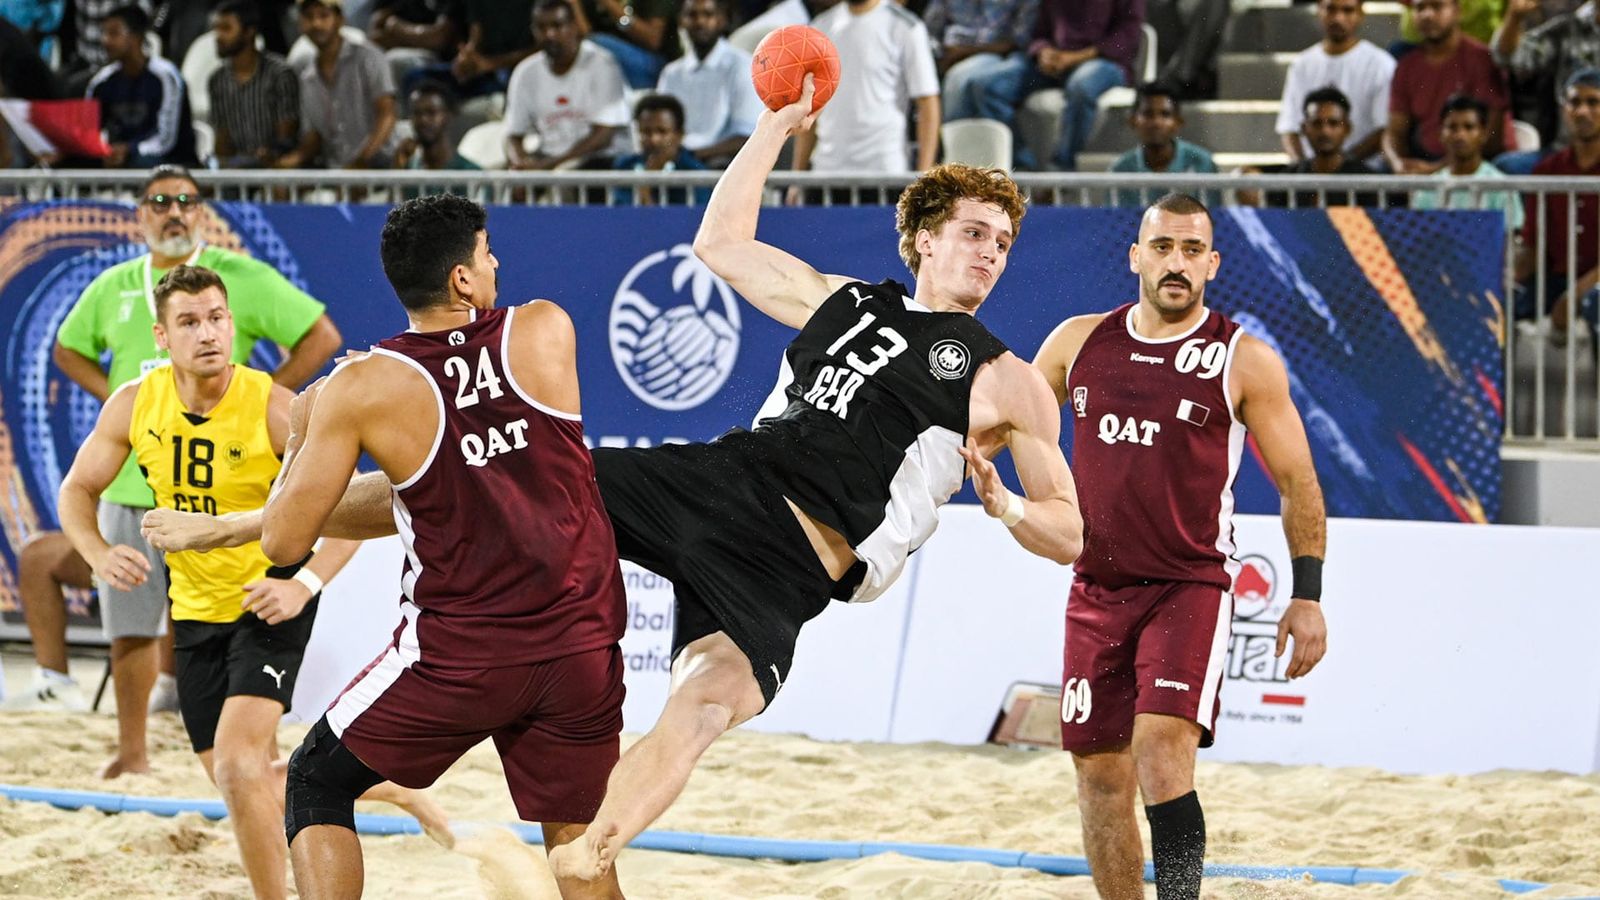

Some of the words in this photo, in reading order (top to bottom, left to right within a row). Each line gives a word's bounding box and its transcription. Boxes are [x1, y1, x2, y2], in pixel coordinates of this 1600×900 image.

[826, 311, 909, 376] 13
[1130, 352, 1165, 365] Kempa
[1174, 338, 1227, 379] 69
[444, 346, 504, 409] 24
[803, 365, 865, 420] GER
[460, 418, 528, 467] QAT
[1097, 413, 1161, 446] QAT
[172, 435, 215, 489] 18
[1062, 677, 1092, 724] 69
[1155, 678, 1190, 691] Kempa
